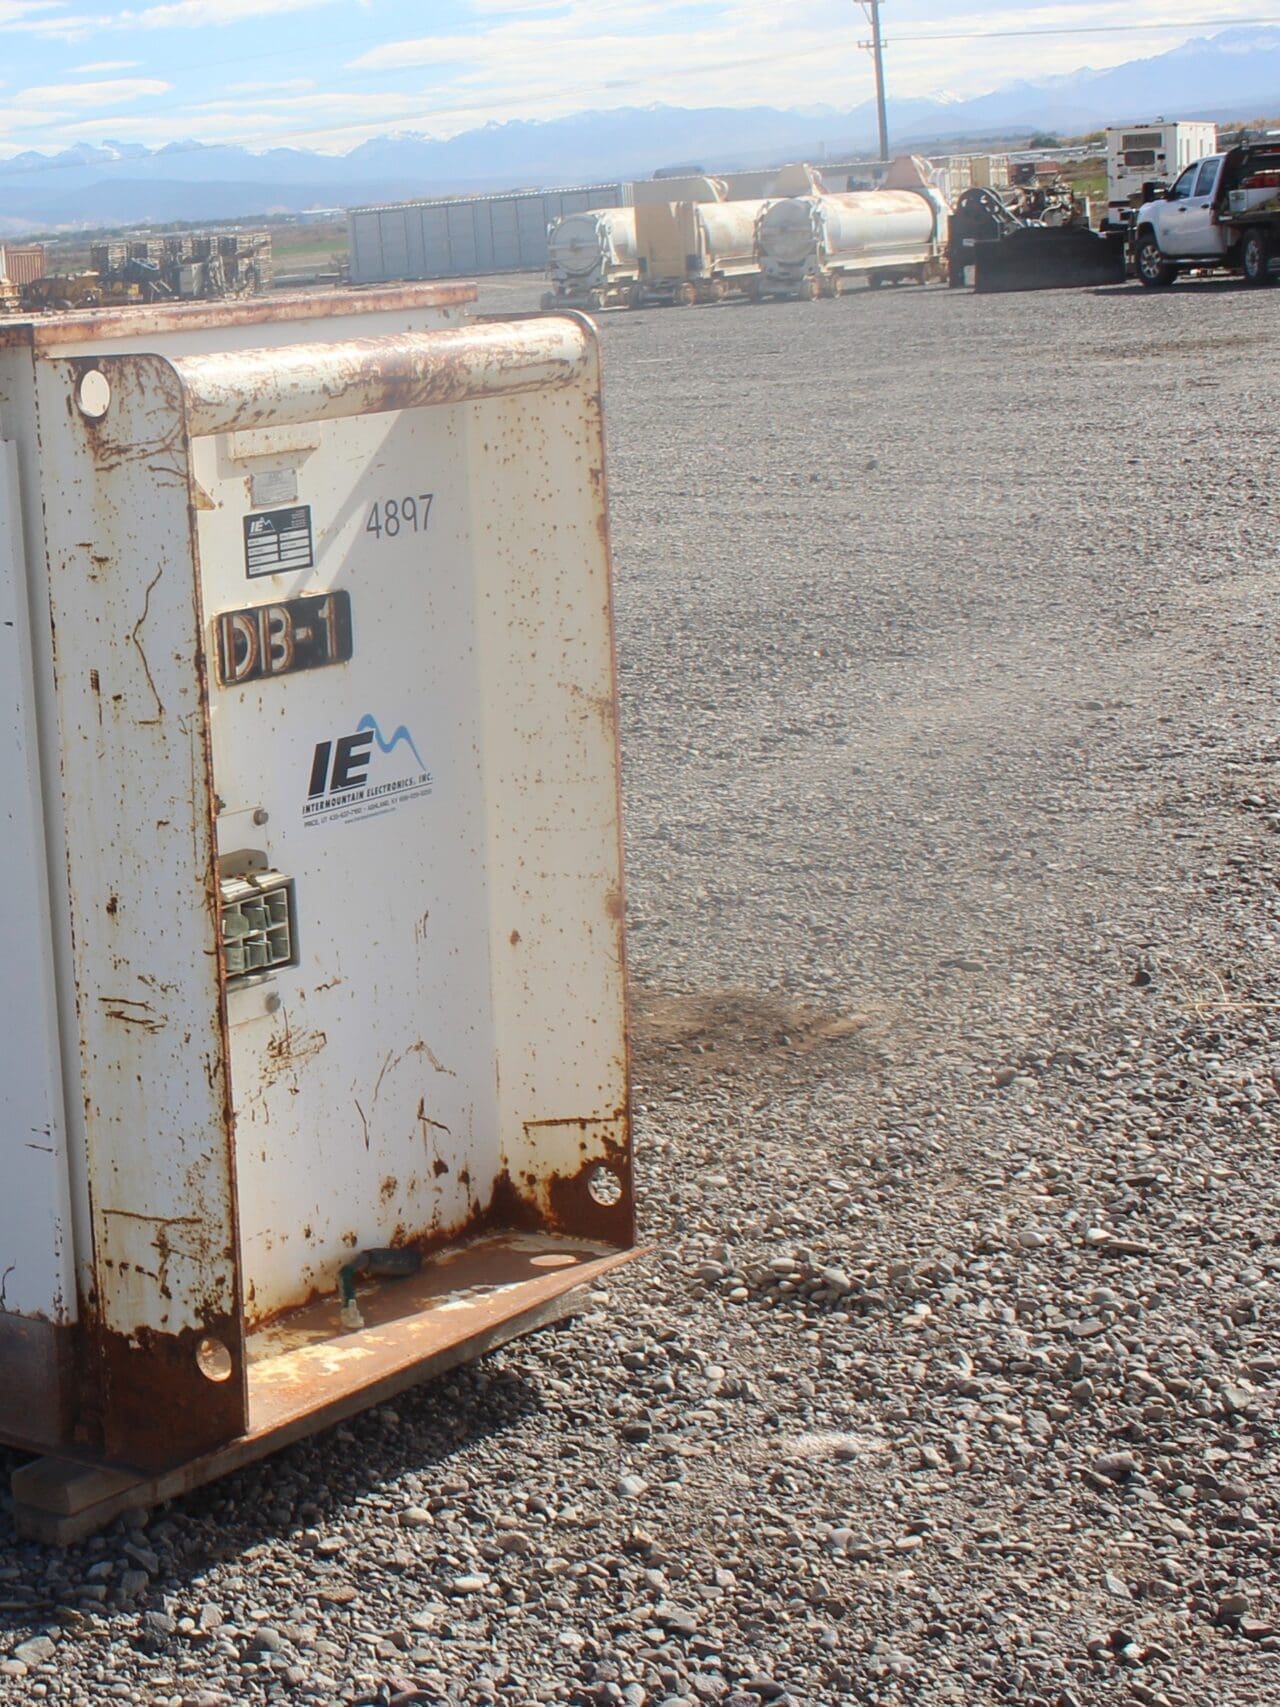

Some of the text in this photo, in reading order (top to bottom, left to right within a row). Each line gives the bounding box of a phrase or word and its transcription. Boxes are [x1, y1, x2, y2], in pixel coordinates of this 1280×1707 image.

[366, 493, 434, 540] 4897
[221, 594, 340, 682] DB-1
[302, 791, 364, 815] INTERMOUNTAIN
[418, 772, 433, 784] INC.
